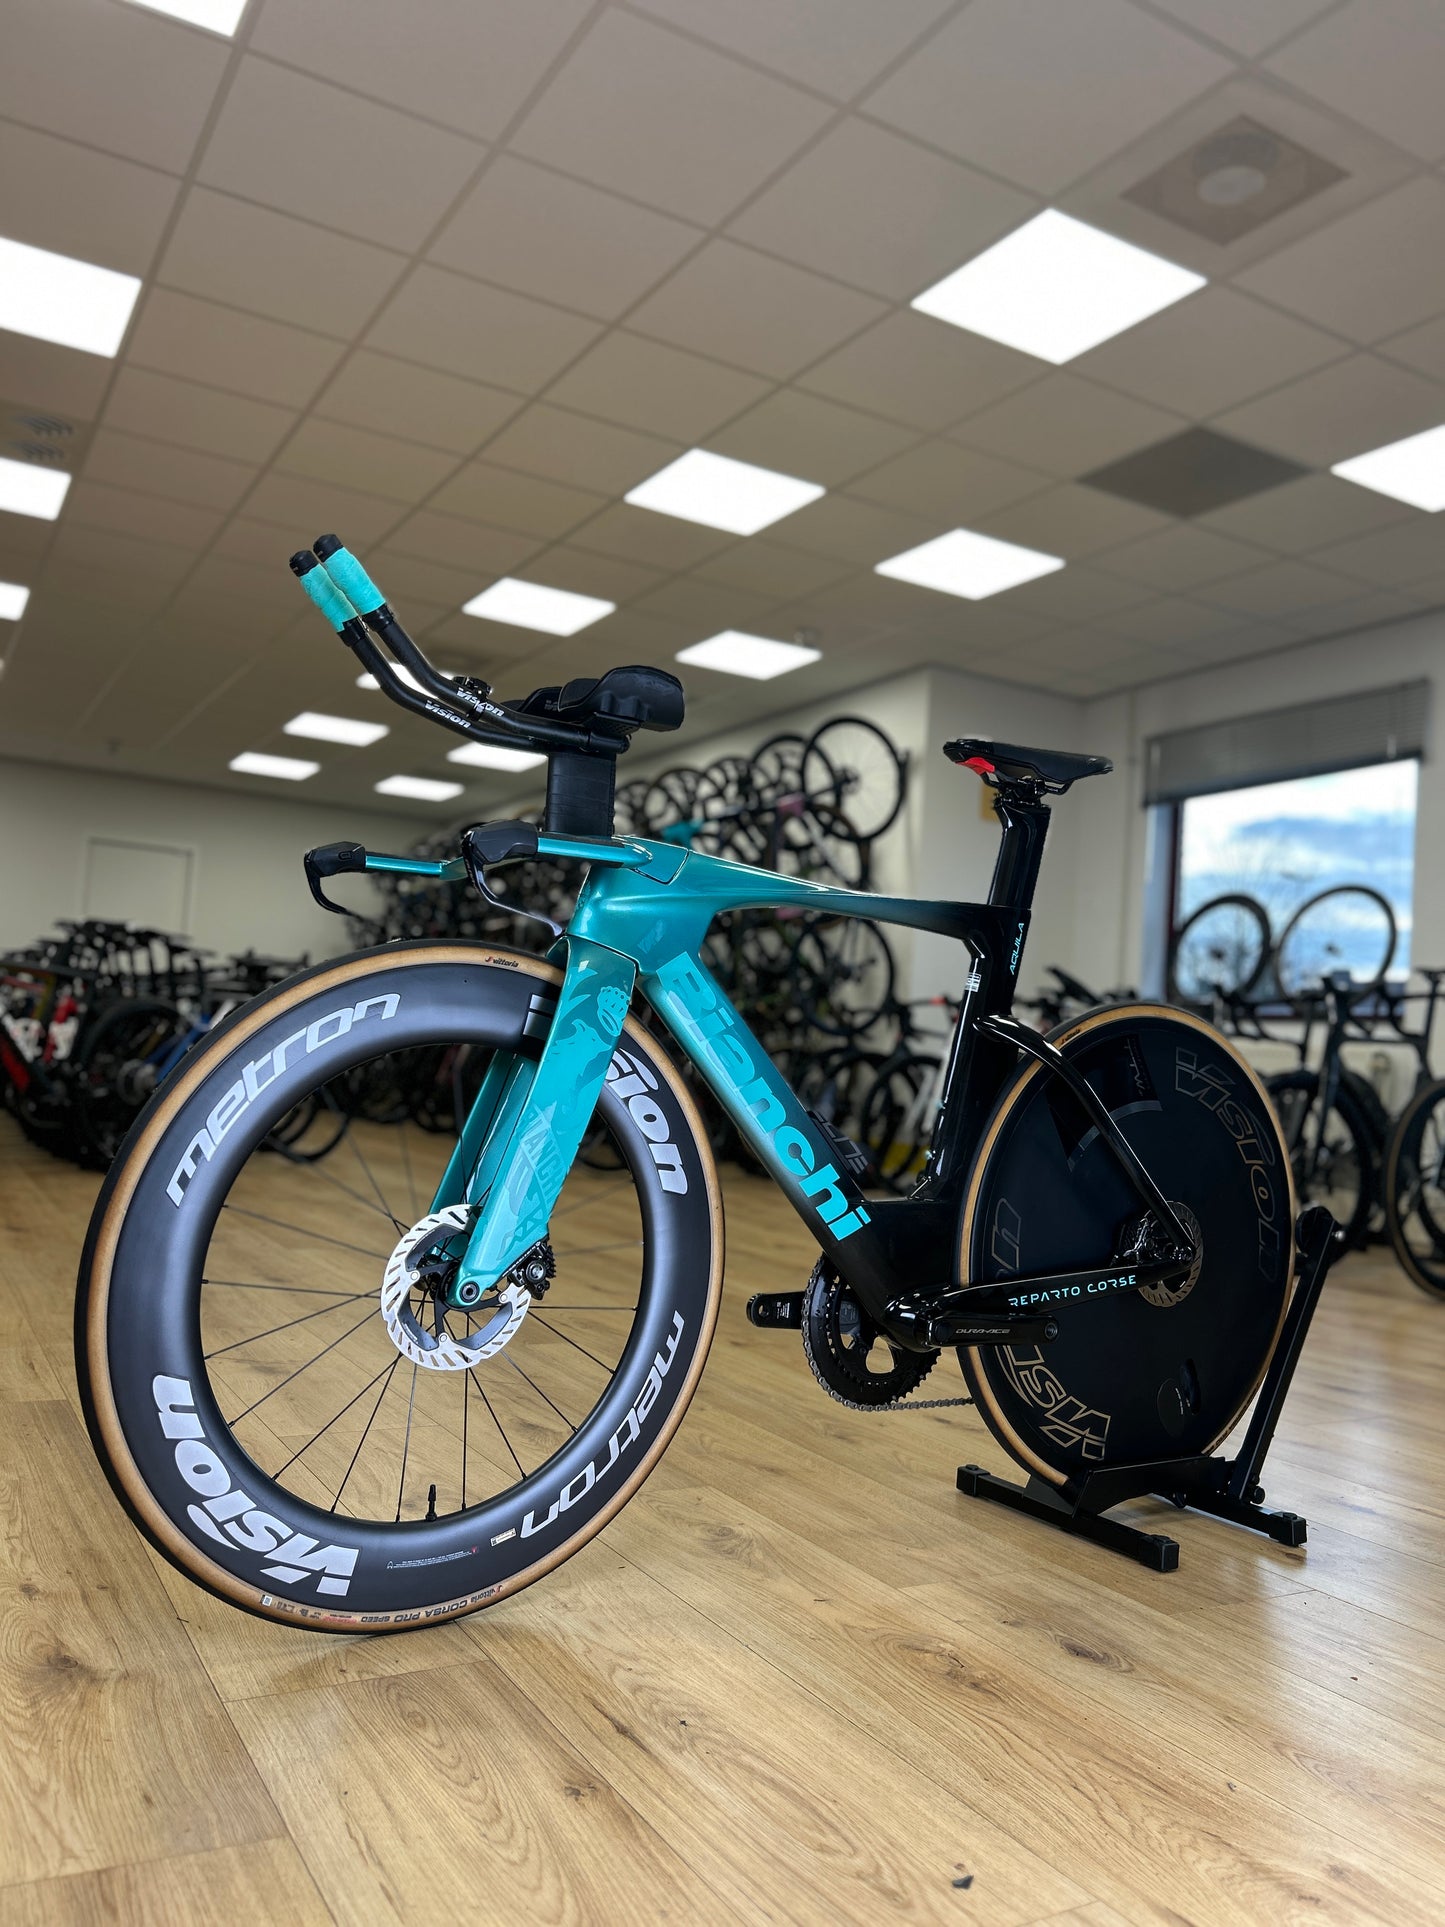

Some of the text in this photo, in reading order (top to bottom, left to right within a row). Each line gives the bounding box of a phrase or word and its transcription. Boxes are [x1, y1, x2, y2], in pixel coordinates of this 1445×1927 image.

[493, 957, 520, 968] vittoria
[1009, 922, 1025, 976] AQUILA
[166, 993, 400, 1207] metron
[656, 951, 872, 1241] Bianchi
[1008, 1275, 1137, 1307] REPARTO CORSE
[520, 1310, 685, 1539] metron
[360, 1615, 391, 1623] SPEED
[394, 1612, 421, 1623] PRO
[424, 1599, 468, 1618] CORSA
